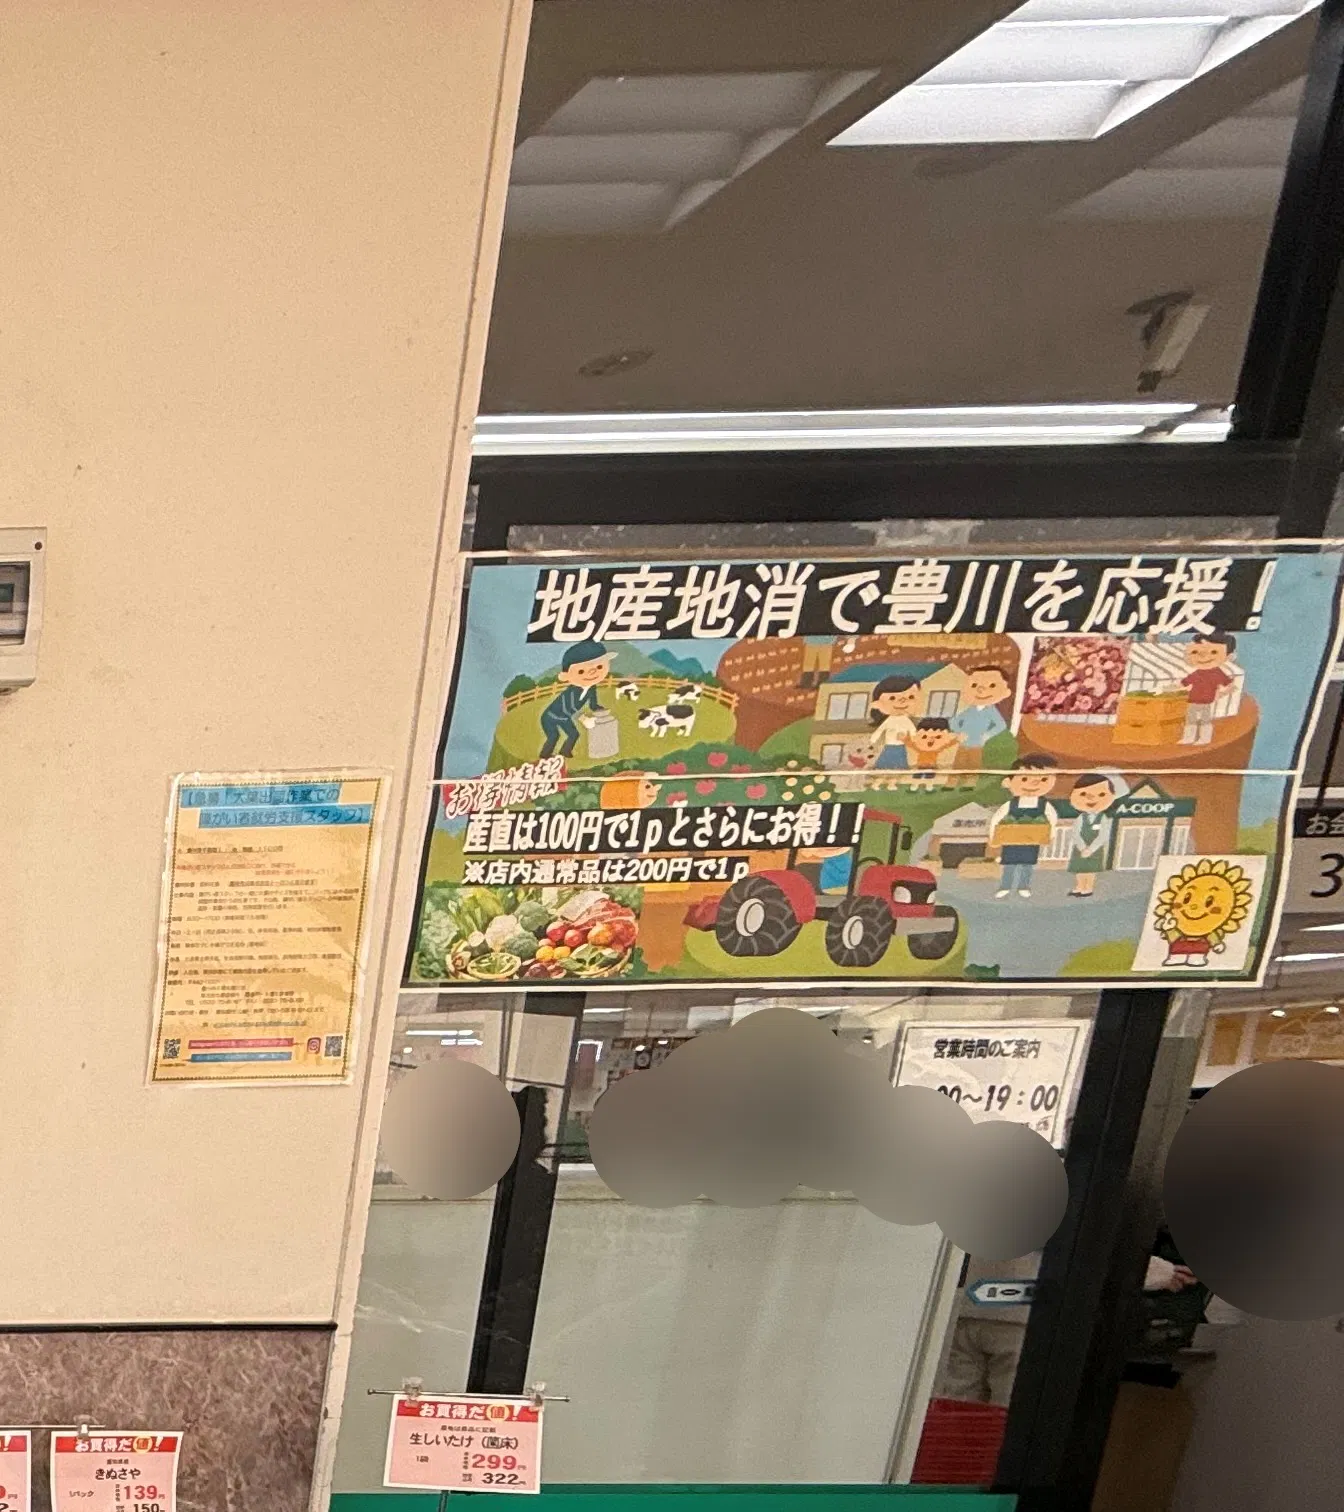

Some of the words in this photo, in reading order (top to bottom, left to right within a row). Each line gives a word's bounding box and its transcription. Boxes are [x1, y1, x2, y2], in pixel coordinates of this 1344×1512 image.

[526, 557, 1279, 641] 地産地消で豊川を応援！
[1116, 802, 1174, 814] A-COOP
[934, 1038, 1041, 1059] 営業時間のご案内
[409, 1432, 518, 1450] 生しいたけ（菌床）
[472, 1453, 526, 1470] 299円
[95, 1468, 141, 1480] きぬさや
[124, 1485, 165, 1500] 139円
